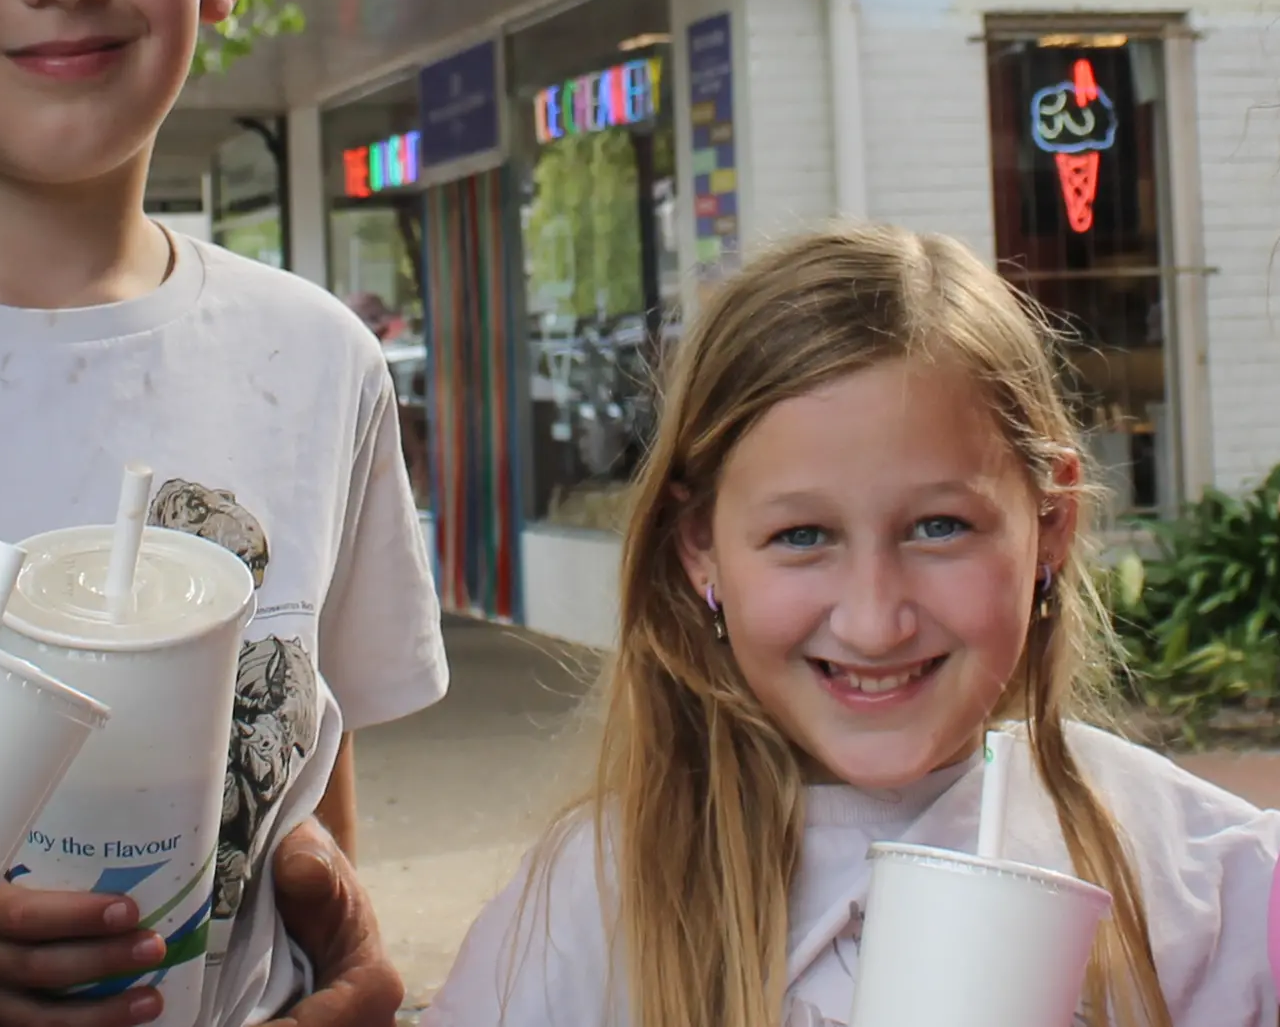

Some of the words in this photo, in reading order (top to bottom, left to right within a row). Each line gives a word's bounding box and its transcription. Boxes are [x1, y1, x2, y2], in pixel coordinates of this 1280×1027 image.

[27, 829, 56, 852] joy
[62, 836, 96, 857] the
[103, 834, 182, 858] Flavour
